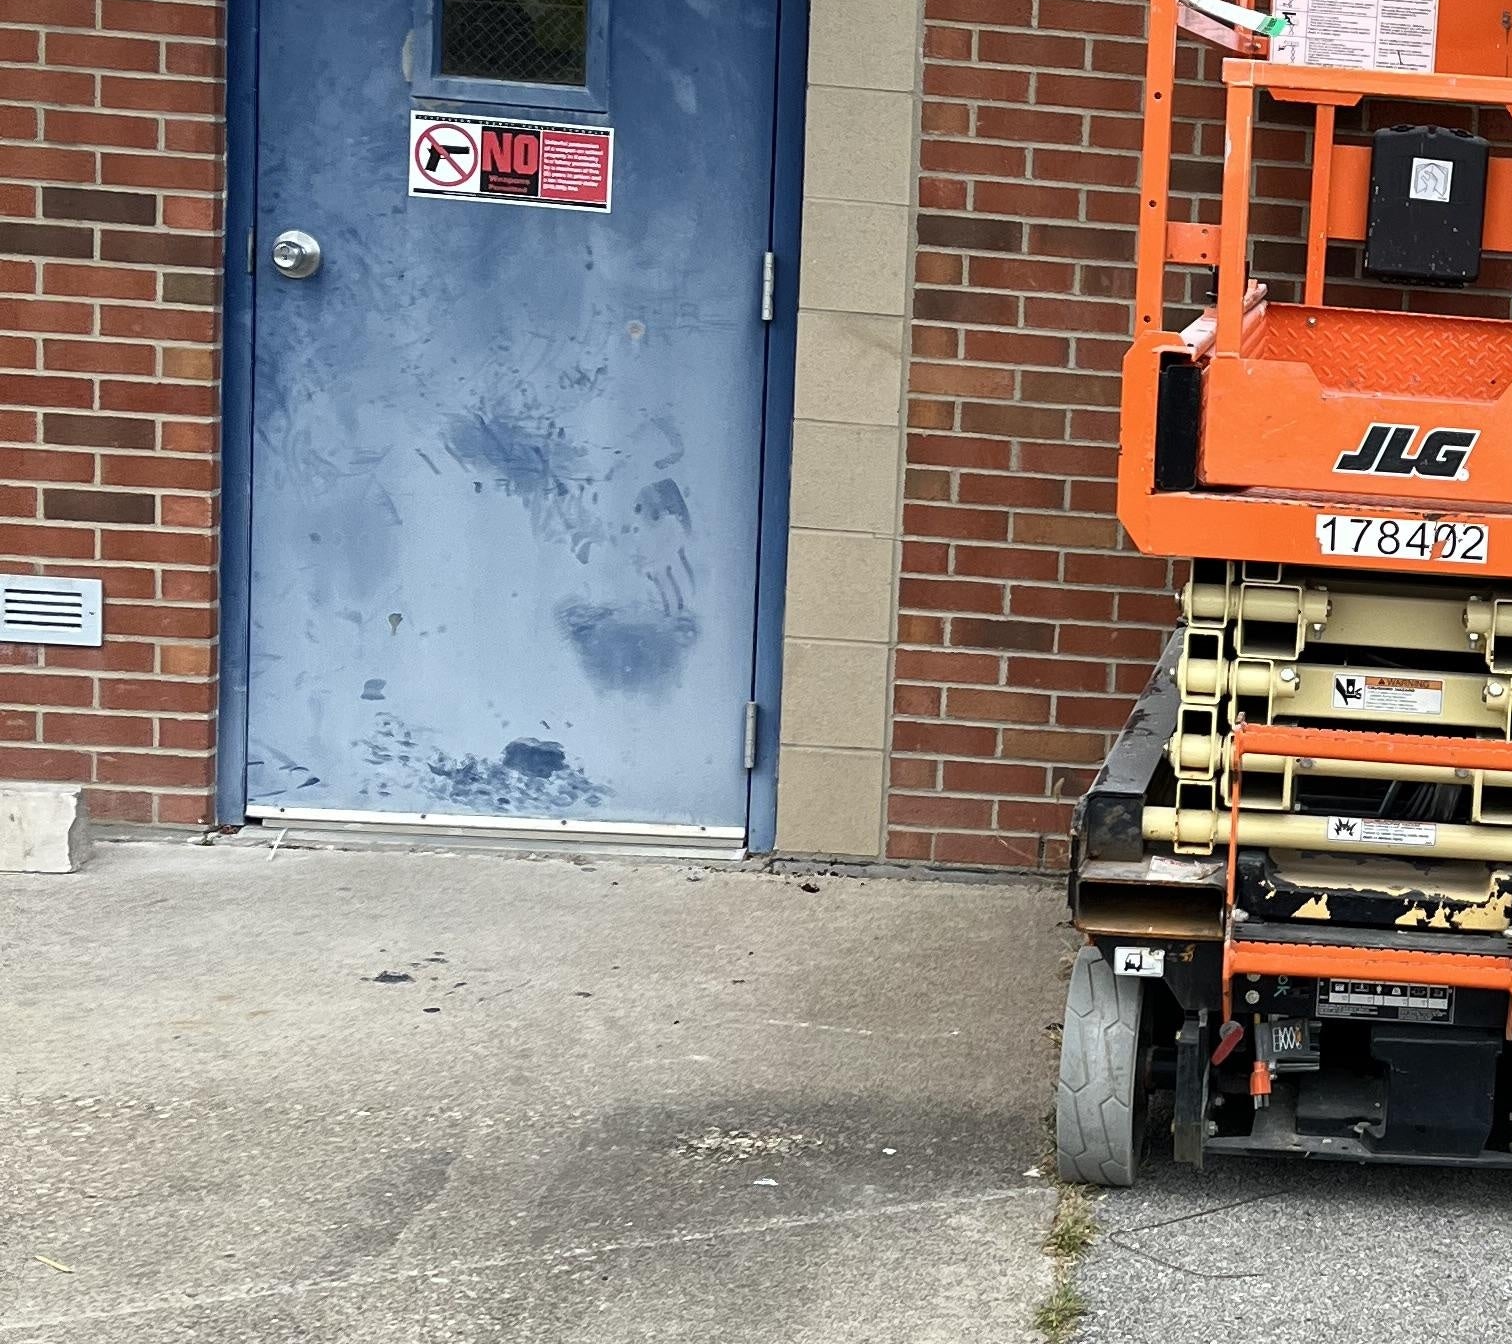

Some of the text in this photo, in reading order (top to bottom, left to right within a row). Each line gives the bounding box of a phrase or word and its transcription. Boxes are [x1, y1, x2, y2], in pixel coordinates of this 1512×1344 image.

[482, 131, 539, 175] NO
[1334, 424, 1479, 479] JLG
[1322, 516, 1485, 560] 178402
[1387, 677, 1430, 689] WARNING
